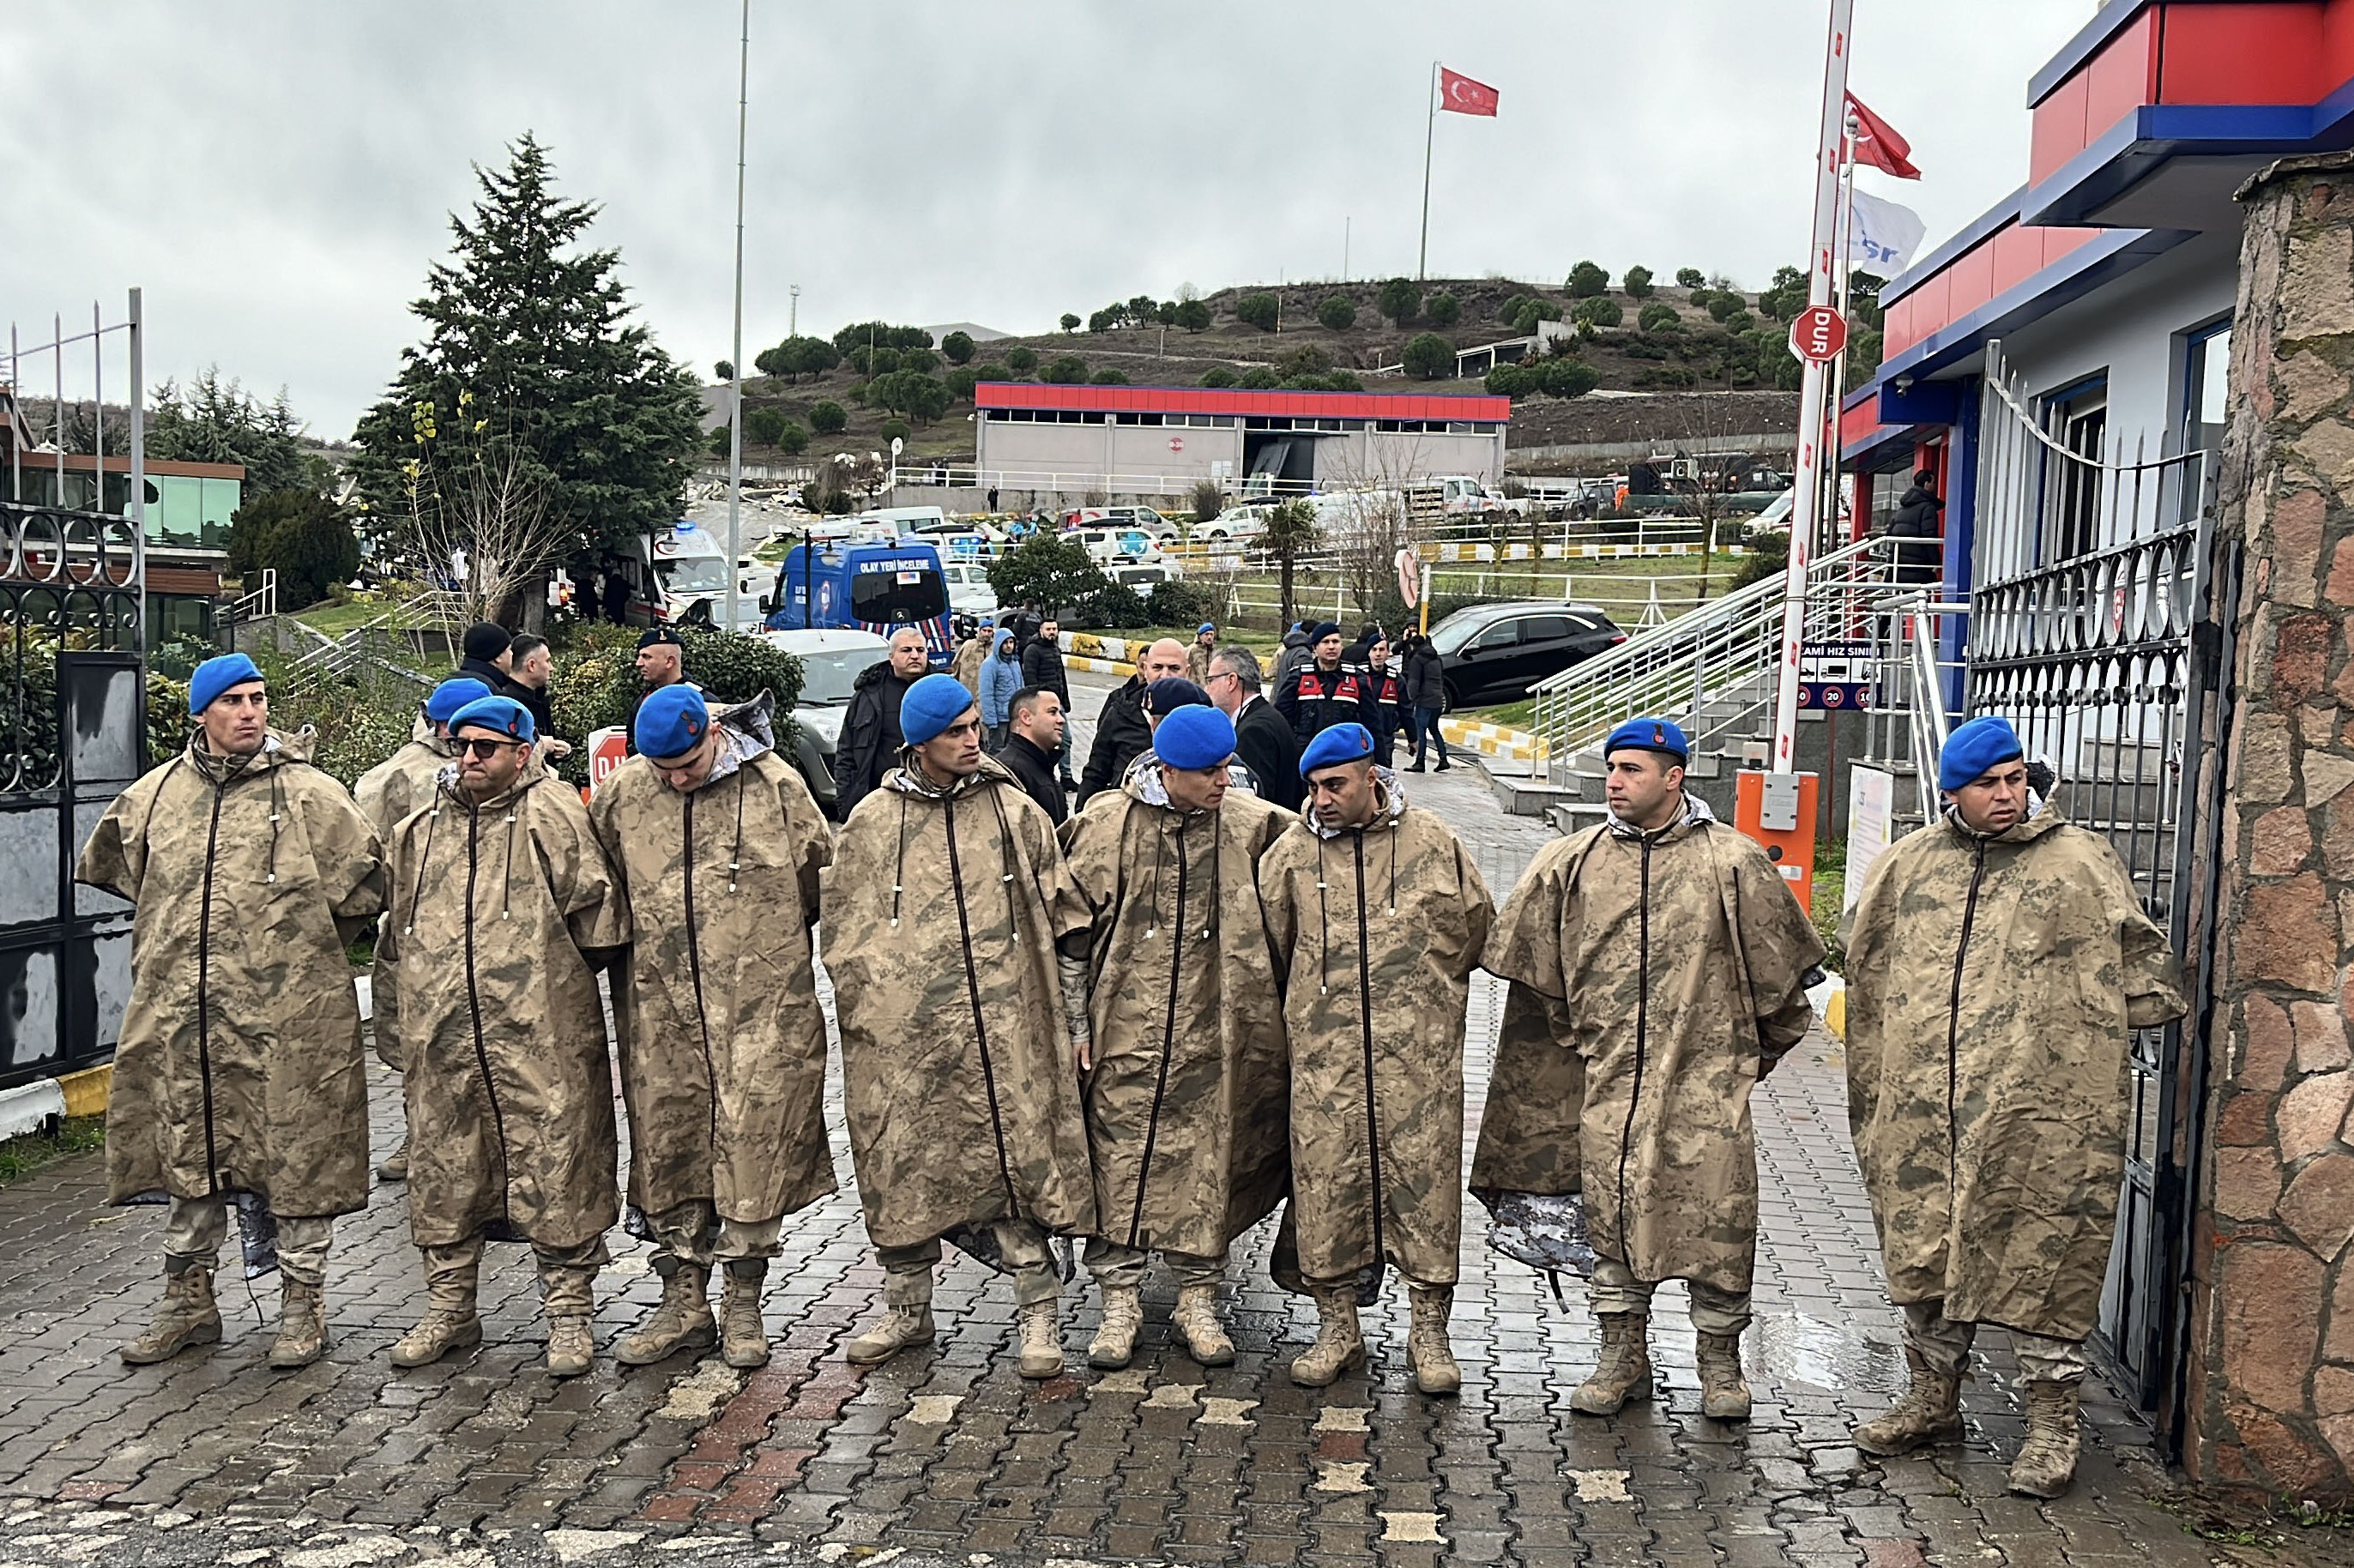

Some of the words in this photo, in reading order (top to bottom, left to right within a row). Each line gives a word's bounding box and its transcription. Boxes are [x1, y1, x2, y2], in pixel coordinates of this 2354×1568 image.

[1811, 312, 1831, 353] DUR
[860, 562, 878, 573] OLAY
[897, 559, 929, 570] İNCELEME
[1801, 646, 1825, 655] AMİ
[1827, 647, 1845, 655] HIZ
